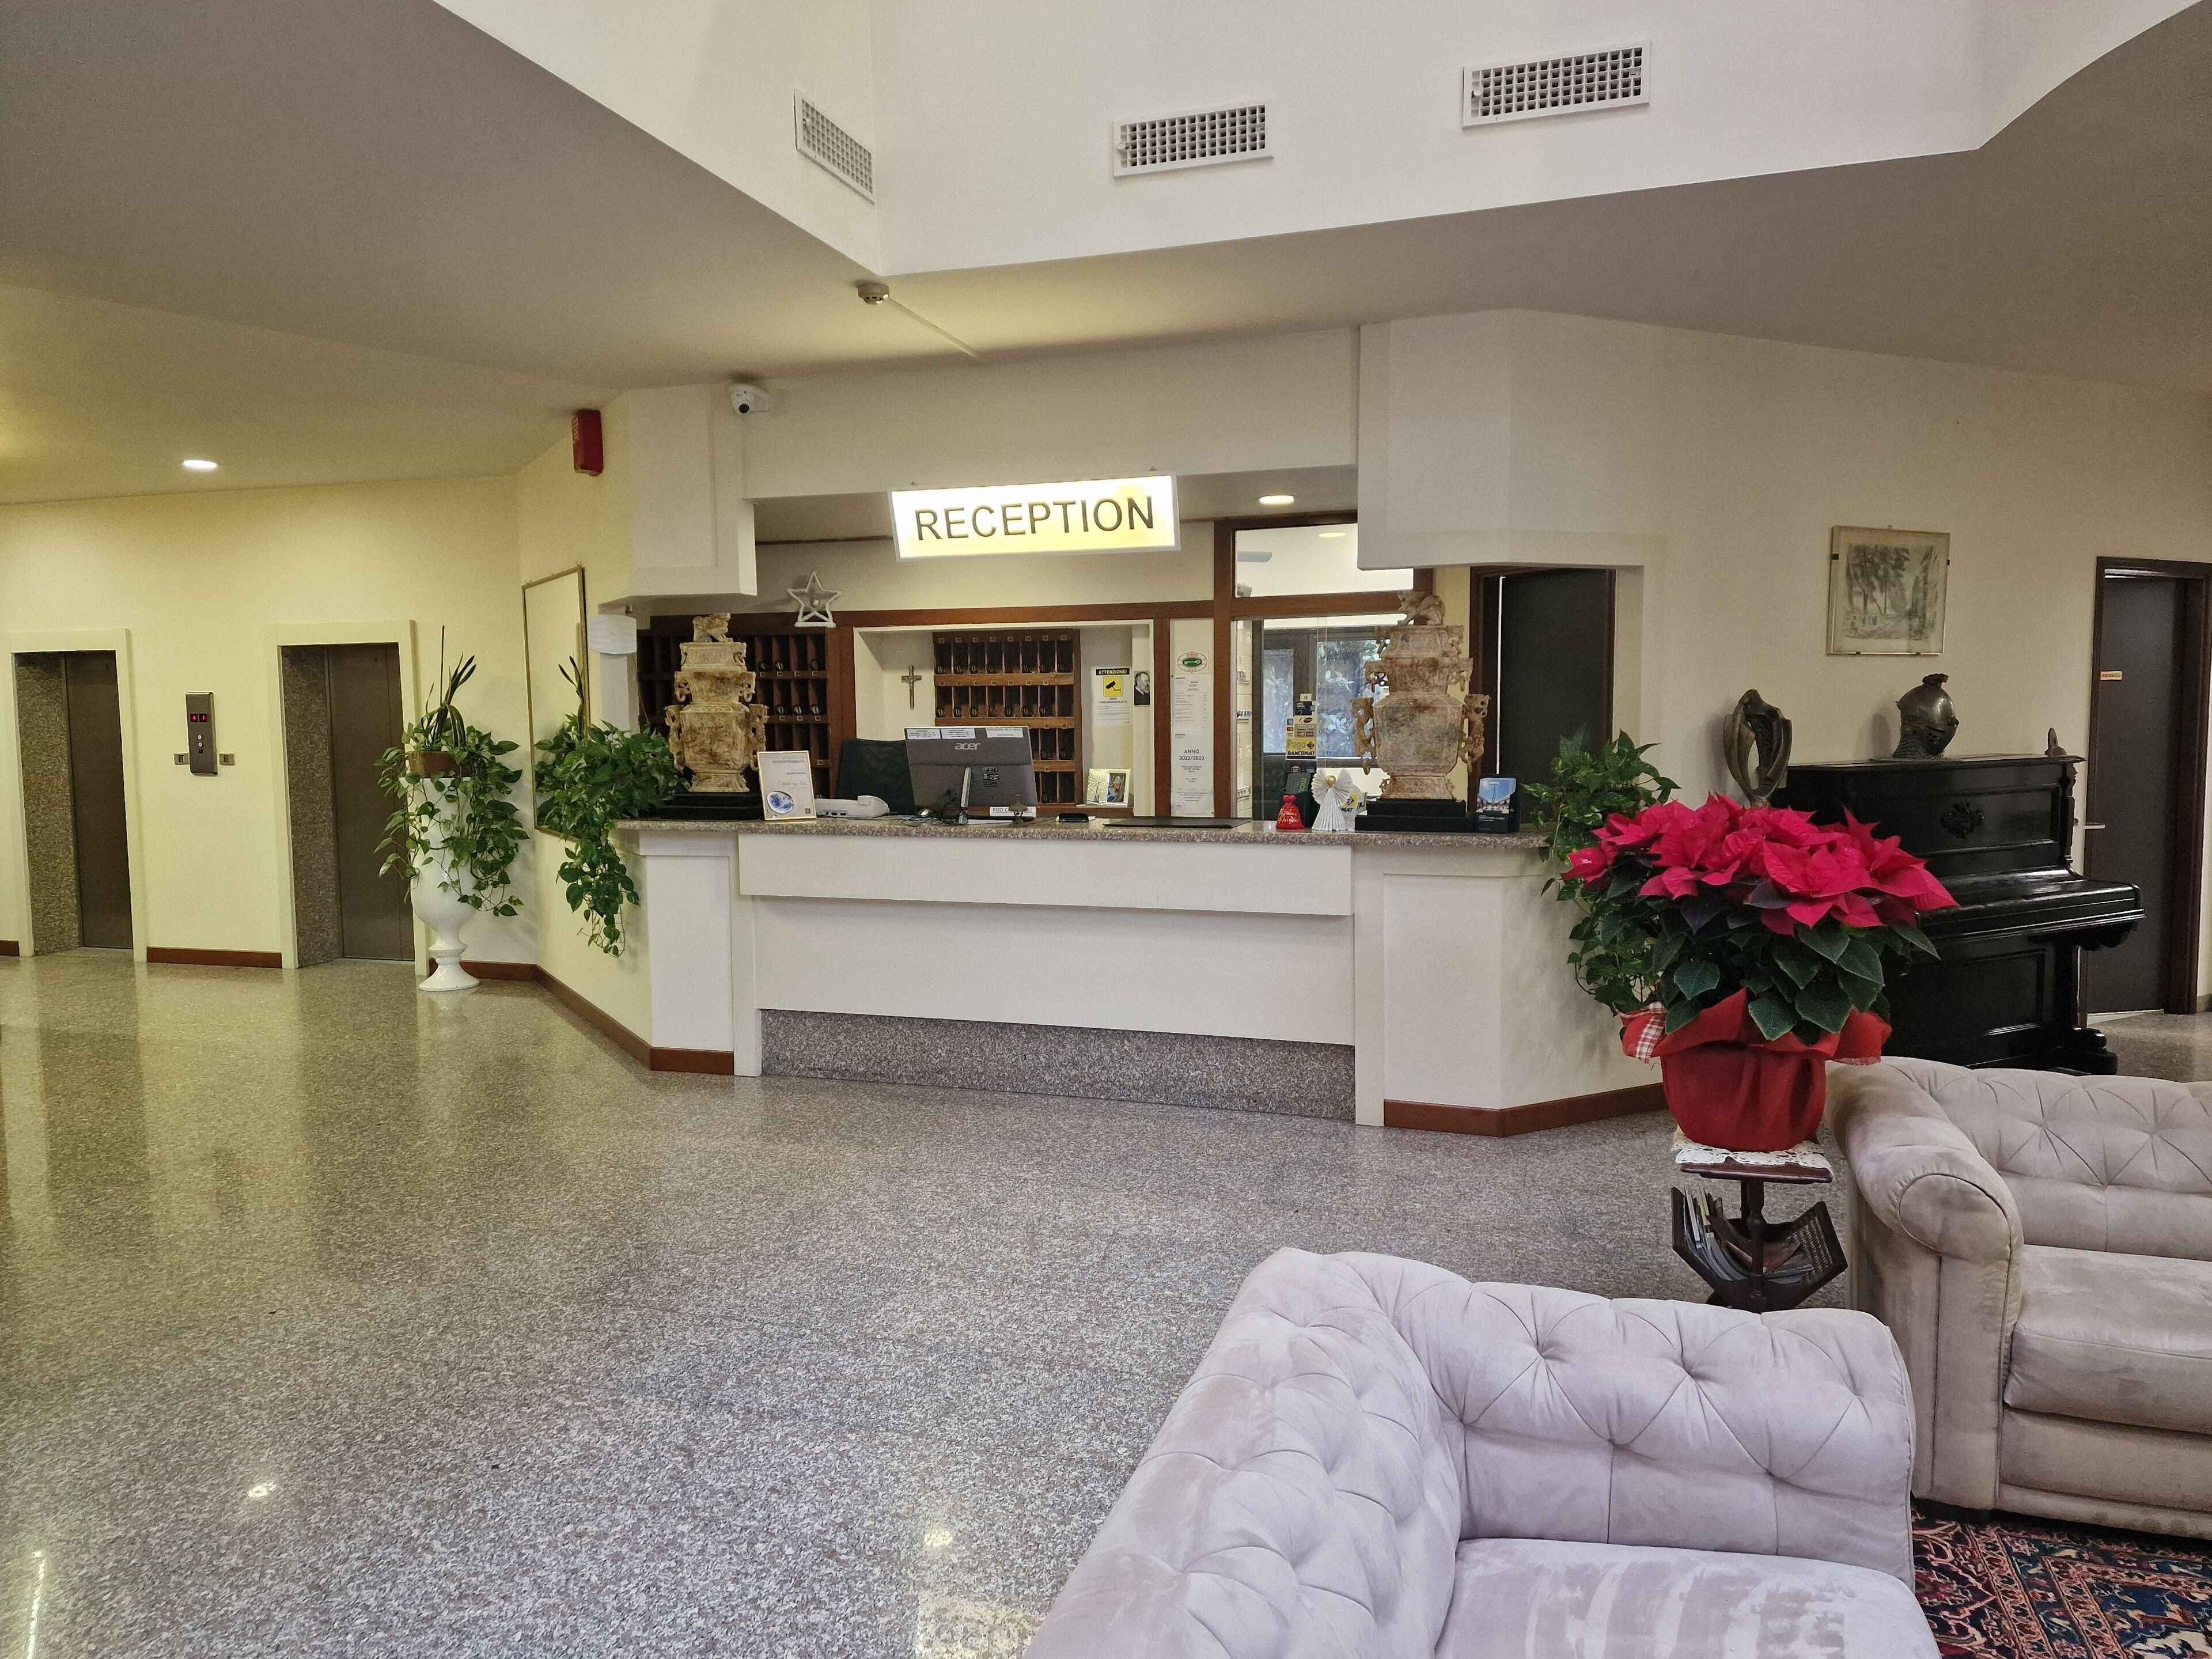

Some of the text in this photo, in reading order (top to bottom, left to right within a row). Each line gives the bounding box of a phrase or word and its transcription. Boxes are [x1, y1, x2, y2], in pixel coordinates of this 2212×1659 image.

[914, 495, 1154, 541] RECEPTION
[955, 743, 981, 751] acer
[1287, 740, 1306, 750] Pago
